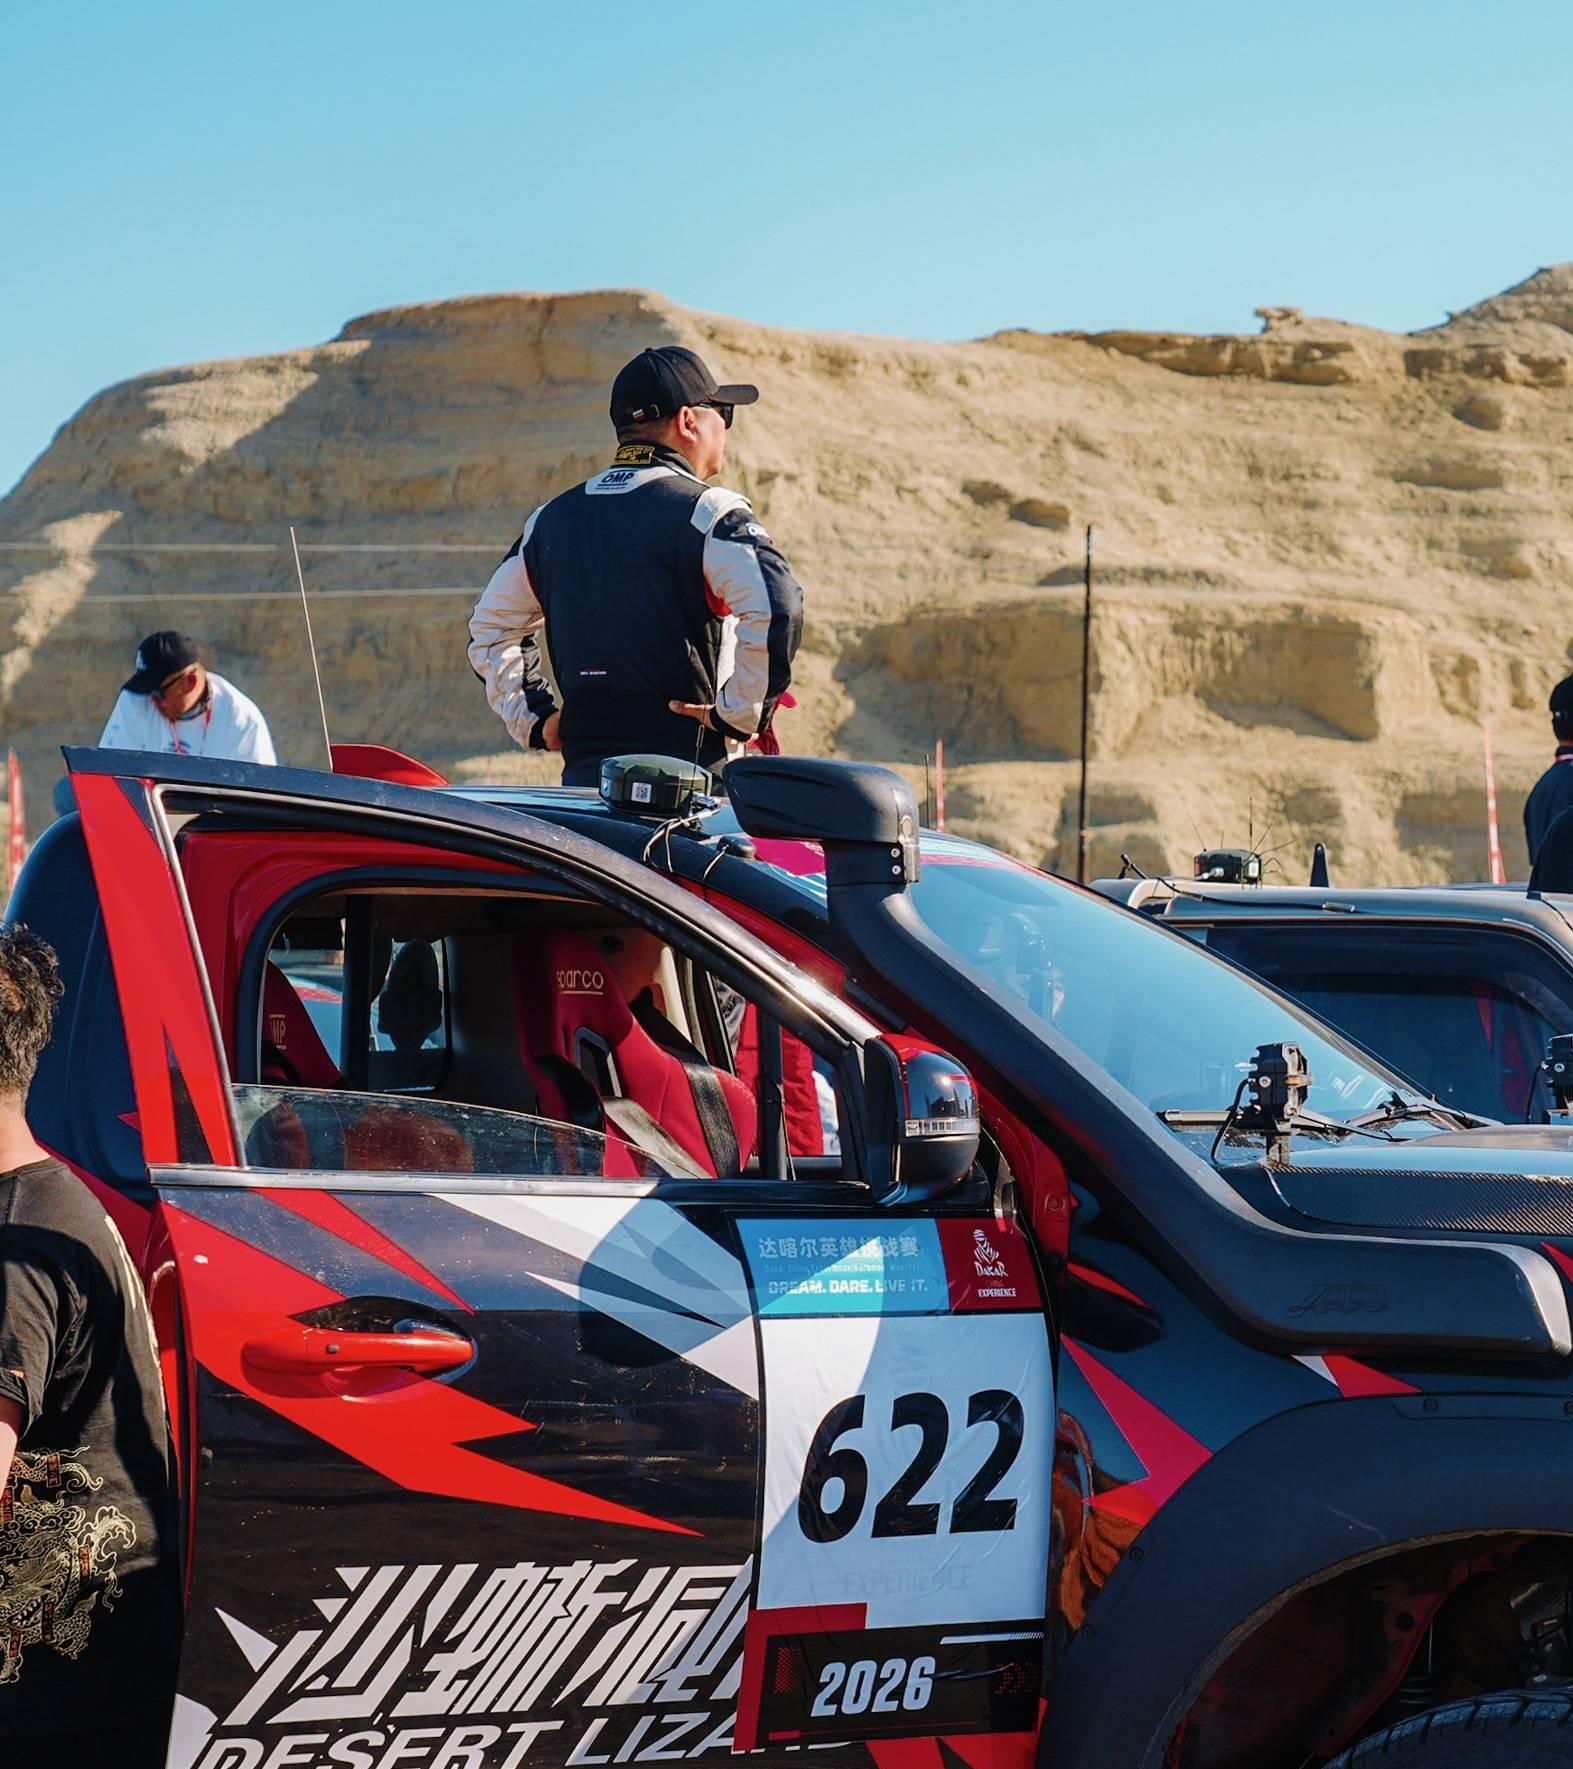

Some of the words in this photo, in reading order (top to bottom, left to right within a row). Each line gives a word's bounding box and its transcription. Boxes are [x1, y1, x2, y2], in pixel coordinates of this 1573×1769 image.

[600, 472, 635, 484] OMP
[759, 1236, 919, 1259] 达喀尔英雄挑战赛
[768, 1279, 827, 1295] DREAM.
[829, 1278, 874, 1294] DARE.
[875, 1278, 906, 1293] LIVE
[911, 1277, 928, 1292] IT.
[977, 1287, 1017, 1298] EXPERIENCE
[798, 1389, 1025, 1543] 622
[809, 1656, 937, 1718] 2026
